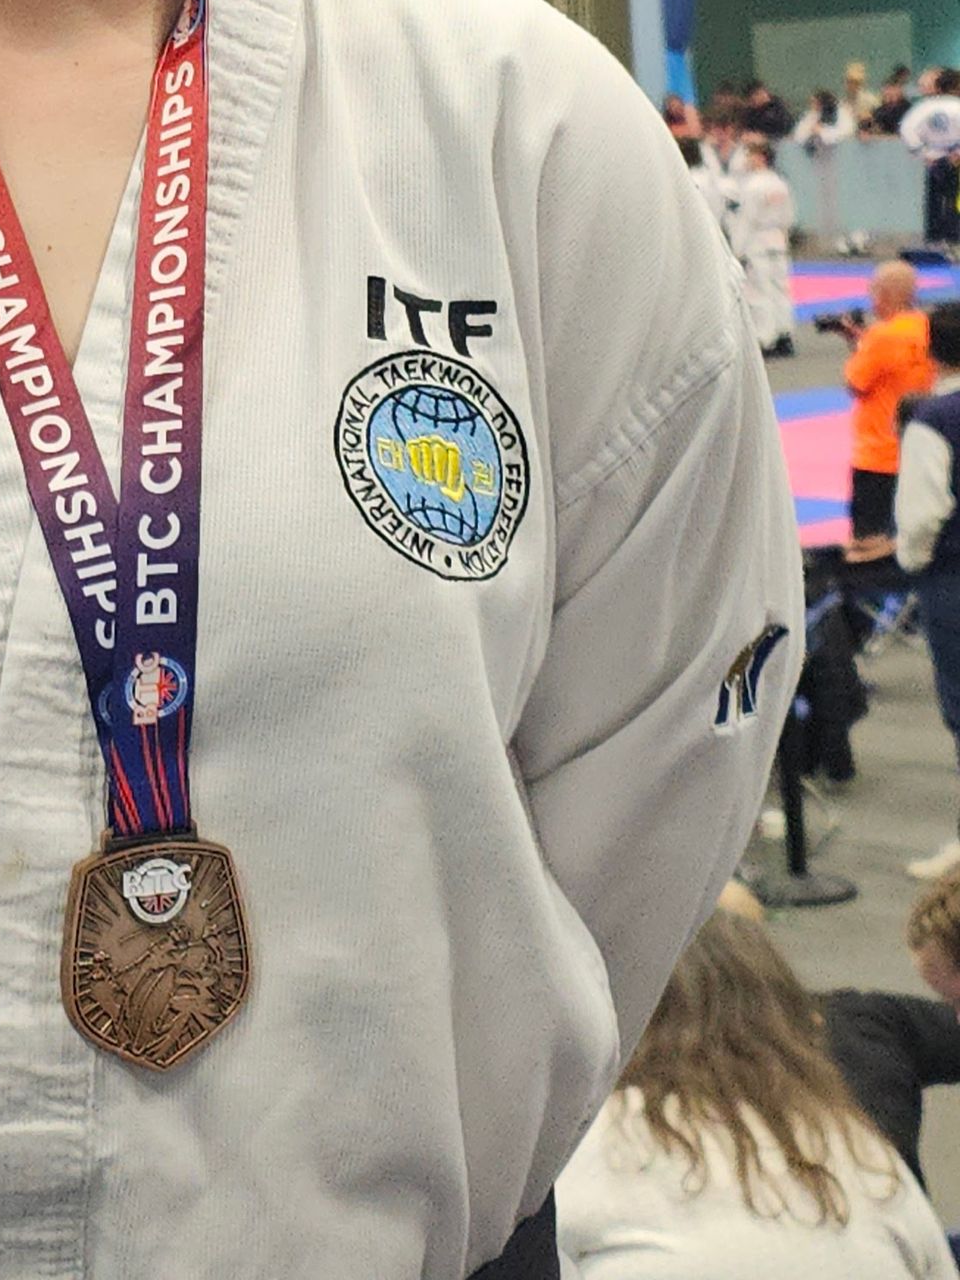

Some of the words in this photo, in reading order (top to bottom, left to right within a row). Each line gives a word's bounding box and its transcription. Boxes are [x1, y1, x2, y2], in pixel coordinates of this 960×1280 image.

[140, 60, 195, 495] CHAMPIONSHIPS
[367, 275, 497, 358] ITF
[343, 386, 435, 562] INTERNATIONAL
[458, 463, 522, 575] FEDERATION
[136, 511, 181, 625] BTC
[123, 864, 192, 899] BTC
